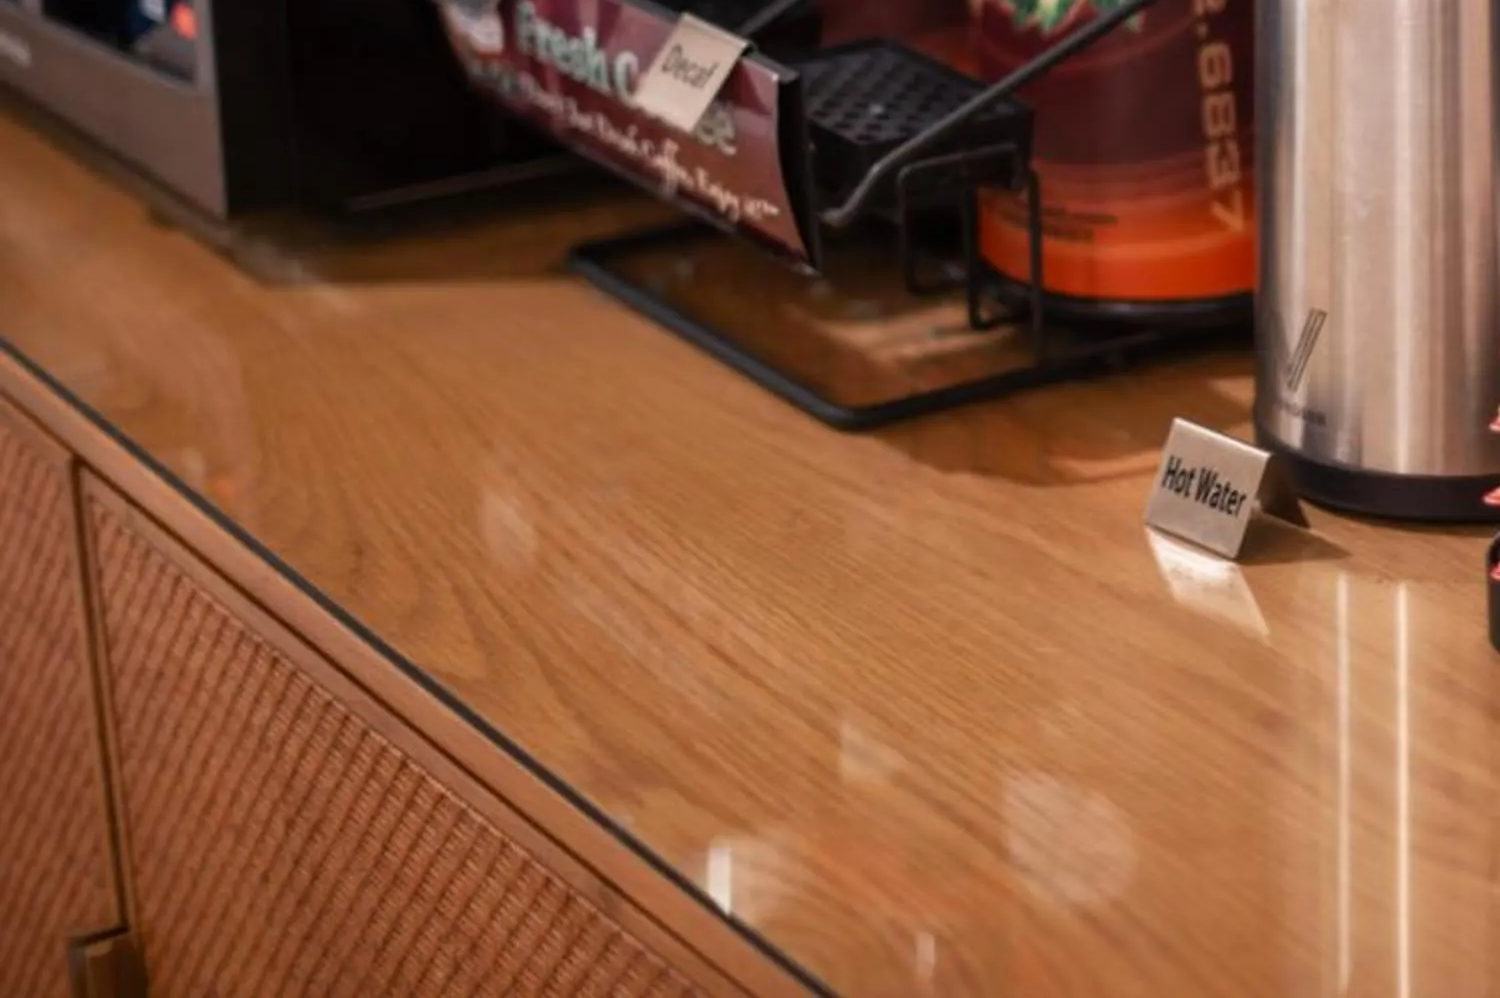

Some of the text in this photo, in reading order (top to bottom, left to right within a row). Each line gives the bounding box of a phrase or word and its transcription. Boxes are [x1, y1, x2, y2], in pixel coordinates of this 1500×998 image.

[662, 44, 720, 89] Decaf
[1161, 455, 1248, 518] Hot Water
